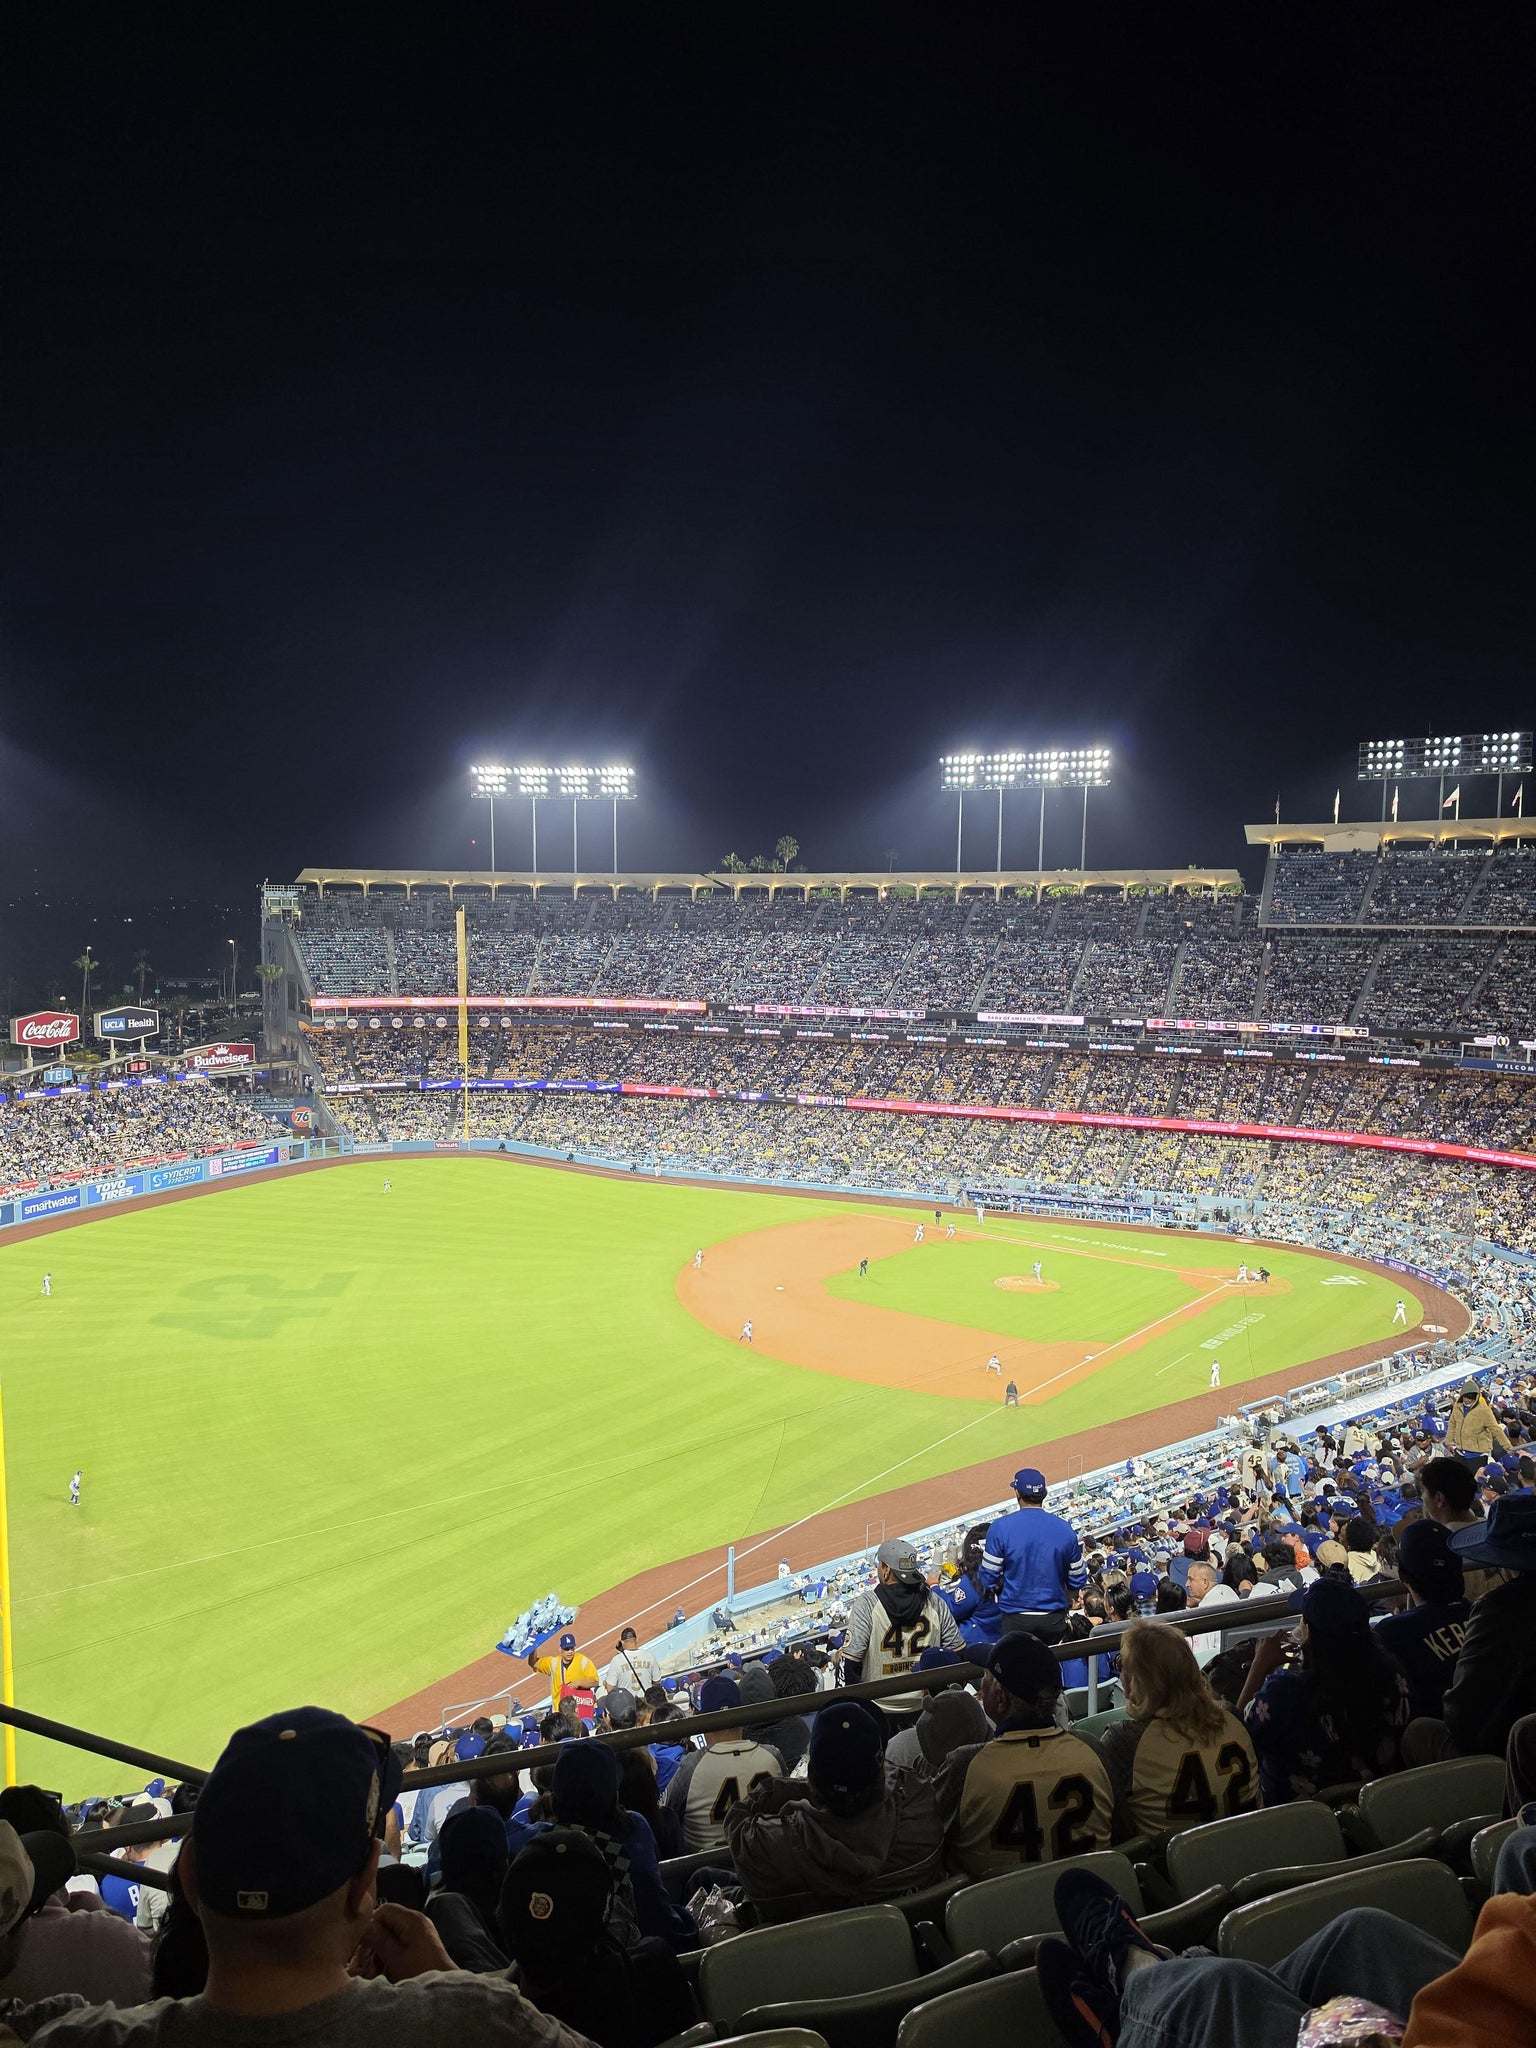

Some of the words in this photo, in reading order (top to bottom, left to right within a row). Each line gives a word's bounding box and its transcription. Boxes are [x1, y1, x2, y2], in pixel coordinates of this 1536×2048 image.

[22, 1018, 74, 1040] Coca-Cola
[104, 1020, 124, 1029] UCLA
[127, 1018, 155, 1029] Health
[193, 1052, 250, 1067] Budweiser
[47, 1070, 70, 1081] TEL
[295, 1112, 310, 1123] 76
[95, 1179, 127, 1194] TOYO
[100, 1186, 135, 1201] TIRES
[24, 1194, 78, 1215] smartwater
[1248, 1455, 1263, 1467] 42
[880, 1615, 931, 1658] 42
[1423, 1620, 1471, 1661] KER
[1166, 1741, 1258, 1823] 42
[990, 1773, 1096, 1863] 42
